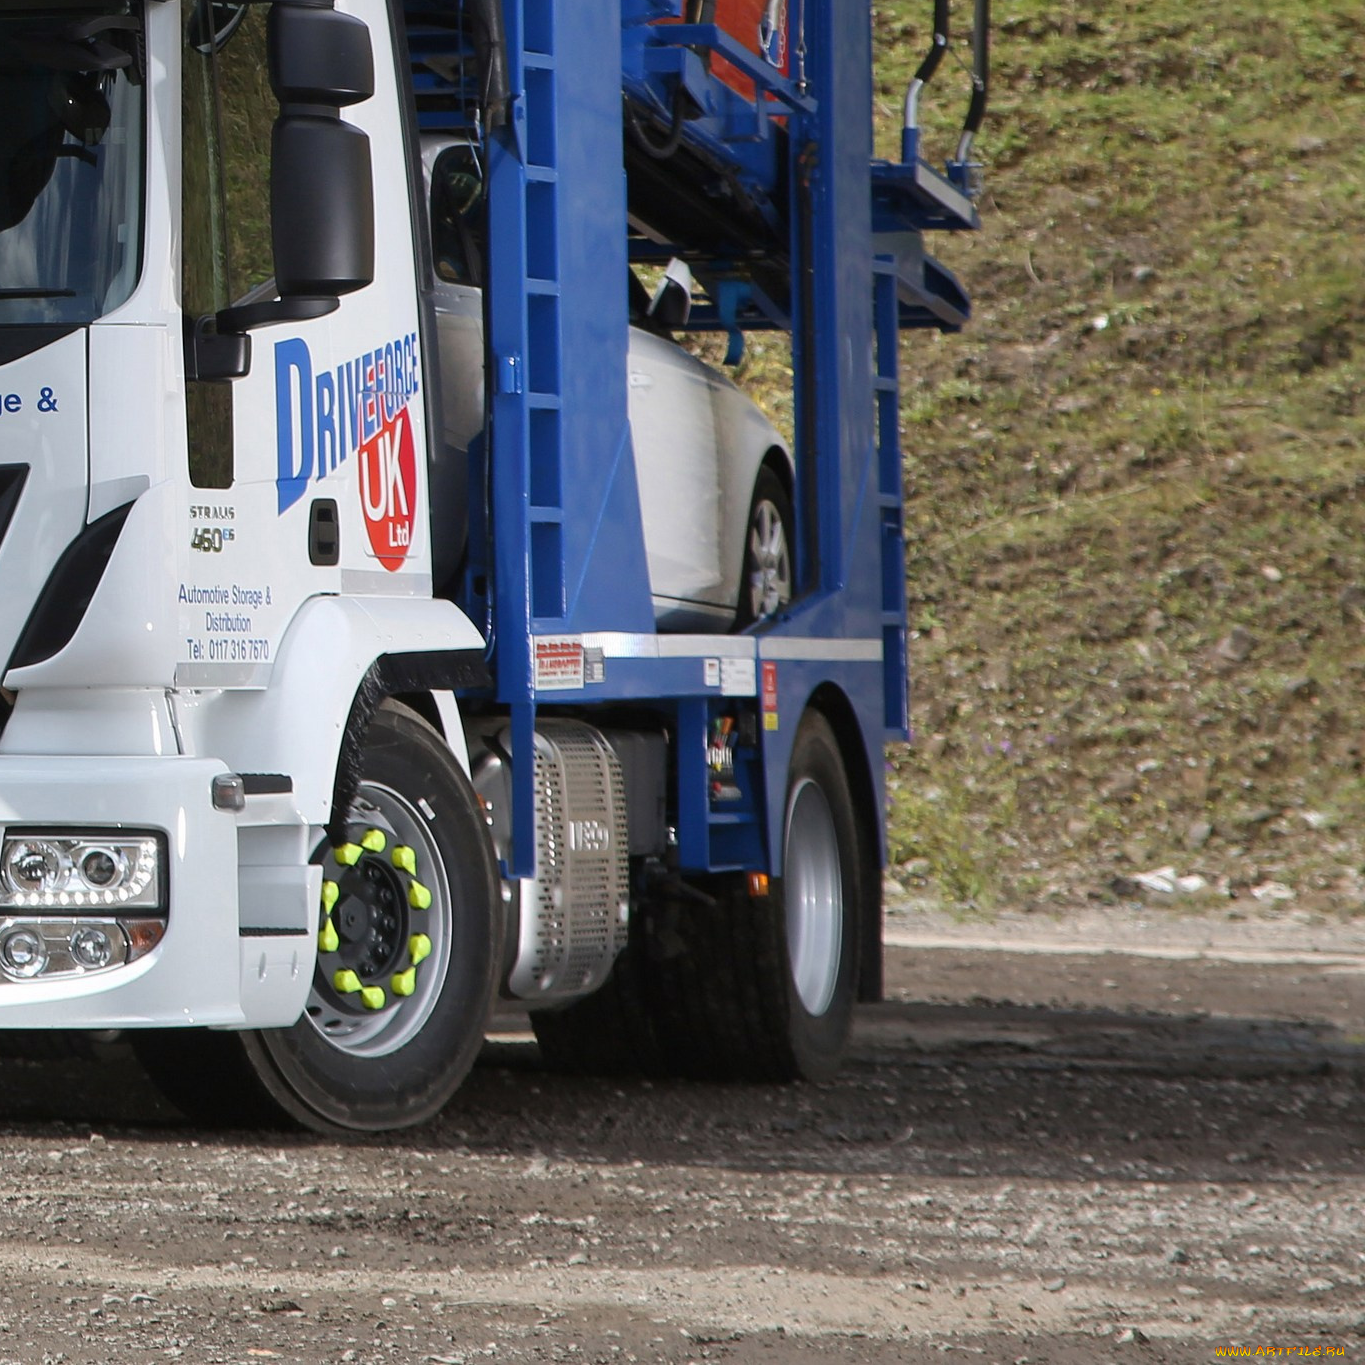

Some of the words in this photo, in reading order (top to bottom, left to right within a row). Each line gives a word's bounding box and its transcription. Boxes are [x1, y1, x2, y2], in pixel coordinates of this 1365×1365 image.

[37, 386, 59, 413] &
[274, 331, 419, 517] DRIVEFORCE
[362, 418, 410, 522] UK
[189, 505, 236, 520] STRALIS
[388, 521, 410, 547] Ltd
[178, 584, 229, 604] Automotive
[232, 584, 263, 609] Storage
[266, 586, 272, 605] &
[205, 612, 251, 632] Distribution
[187, 639, 204, 660] Tel:
[209, 639, 228, 660] 0117
[231, 639, 246, 660] 316
[248, 639, 269, 660] 7670
